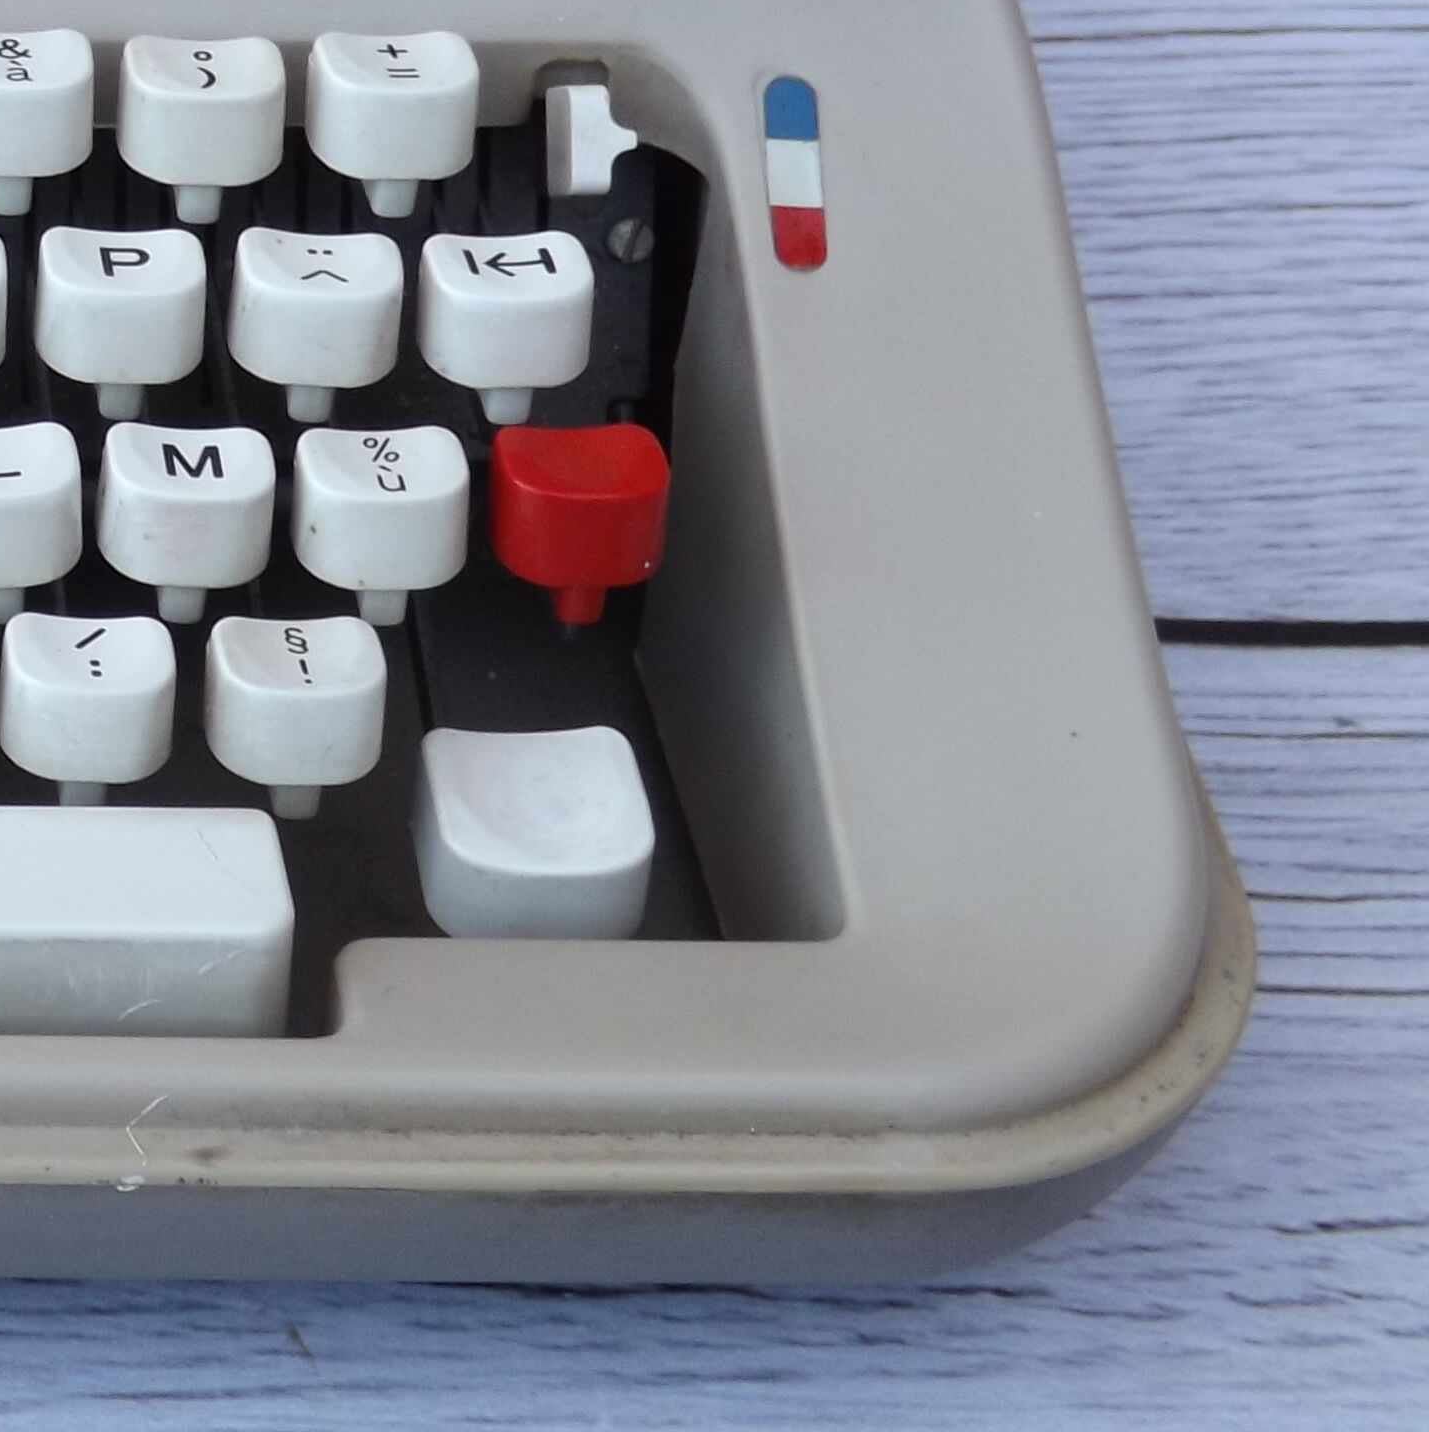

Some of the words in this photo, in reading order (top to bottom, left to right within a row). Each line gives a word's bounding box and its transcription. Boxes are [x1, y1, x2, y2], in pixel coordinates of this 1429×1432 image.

[376, 43, 408, 59] +
[6, 60, 32, 82] à
[197, 66, 217, 89] )
[386, 68, 420, 79] =
[98, 246, 150, 277] P
[161, 443, 224, 479] M
[362, 437, 400, 463] %
[376, 465, 407, 492] ù
[74, 628, 106, 650] /
[283, 627, 309, 655] §
[89, 659, 102, 678] :
[298, 658, 314, 684] !
